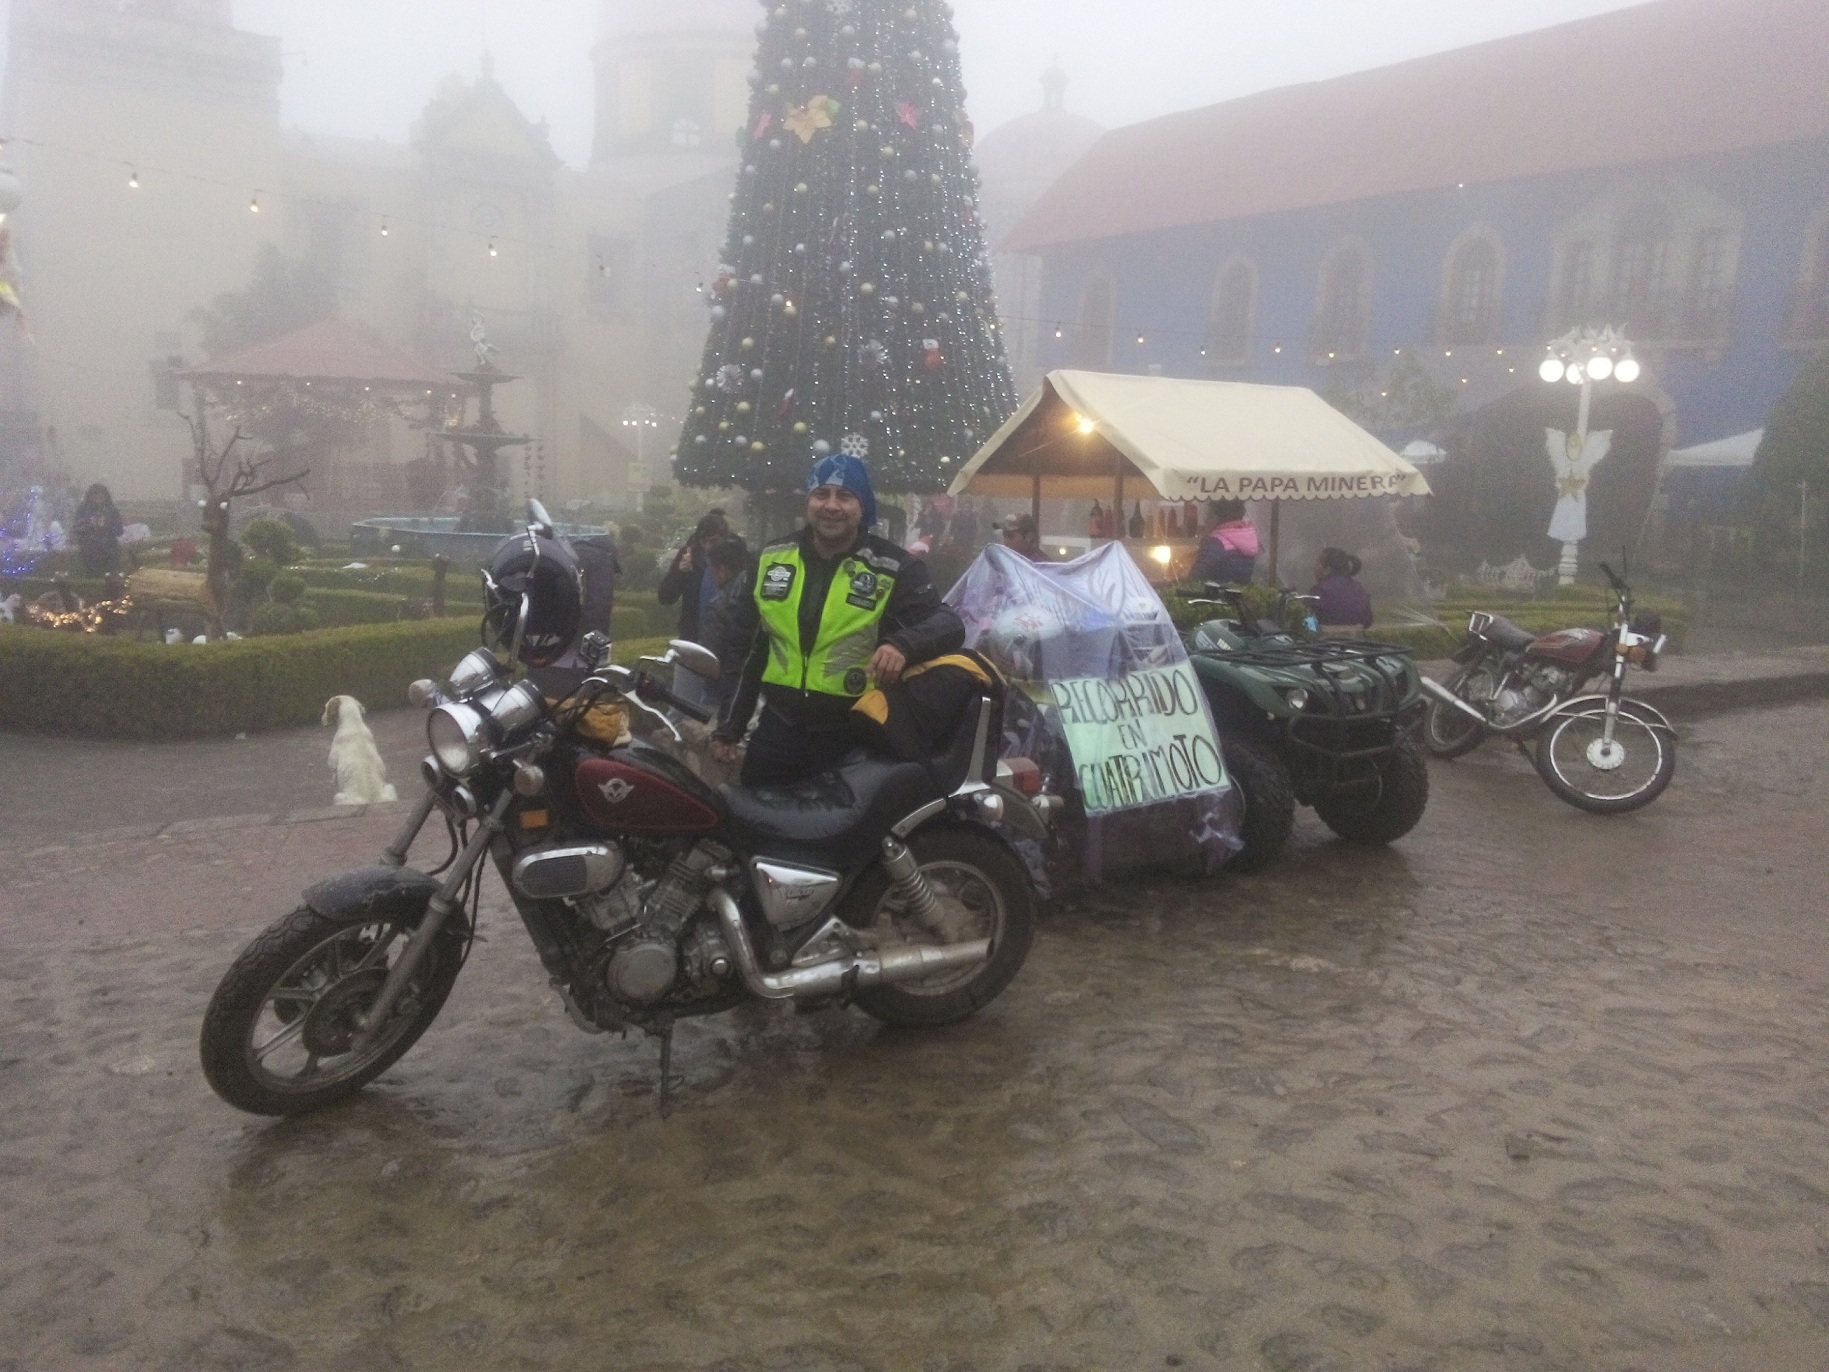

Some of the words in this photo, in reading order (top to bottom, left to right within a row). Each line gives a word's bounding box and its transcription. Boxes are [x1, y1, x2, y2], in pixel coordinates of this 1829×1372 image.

[1238, 476, 1299, 493] PAPA
[1052, 670, 1198, 724] RECORRIDO
[1117, 718, 1147, 750] EN
[1079, 734, 1222, 810] CUATRIMOTO
